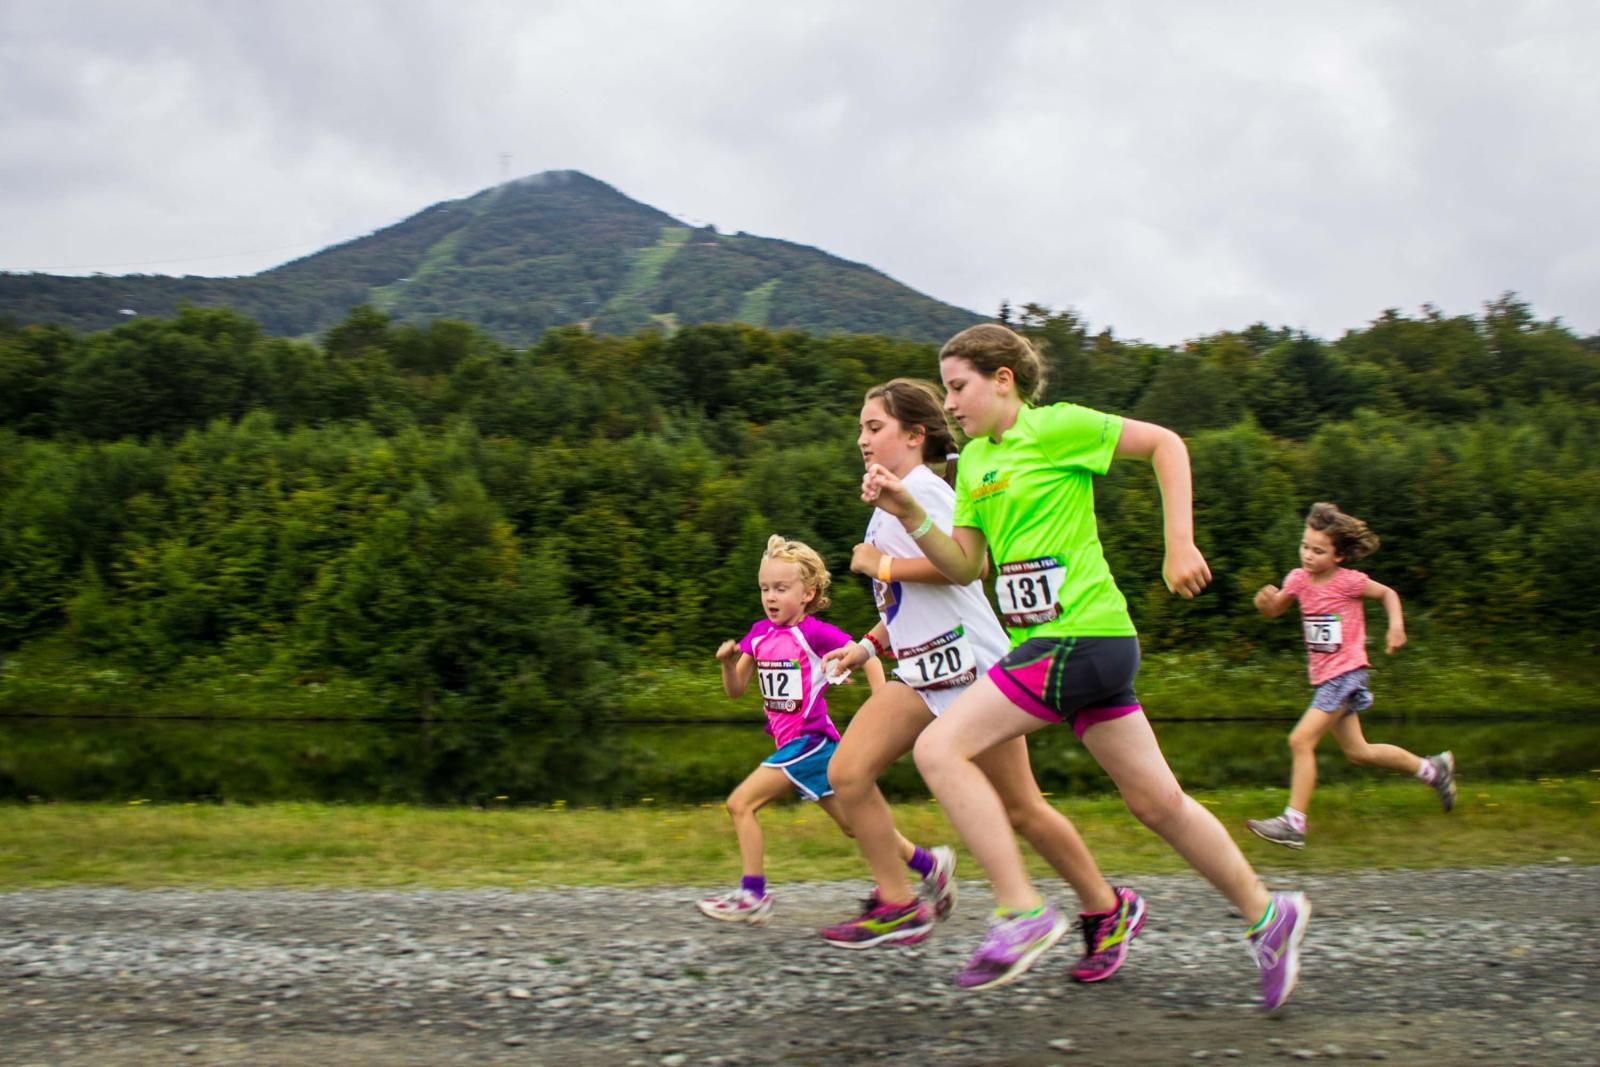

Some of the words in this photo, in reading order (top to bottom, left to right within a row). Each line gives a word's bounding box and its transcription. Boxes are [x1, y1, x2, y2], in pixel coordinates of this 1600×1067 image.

[1006, 575, 1052, 609] 131
[915, 646, 962, 682] 120
[760, 672, 790, 697] 112
